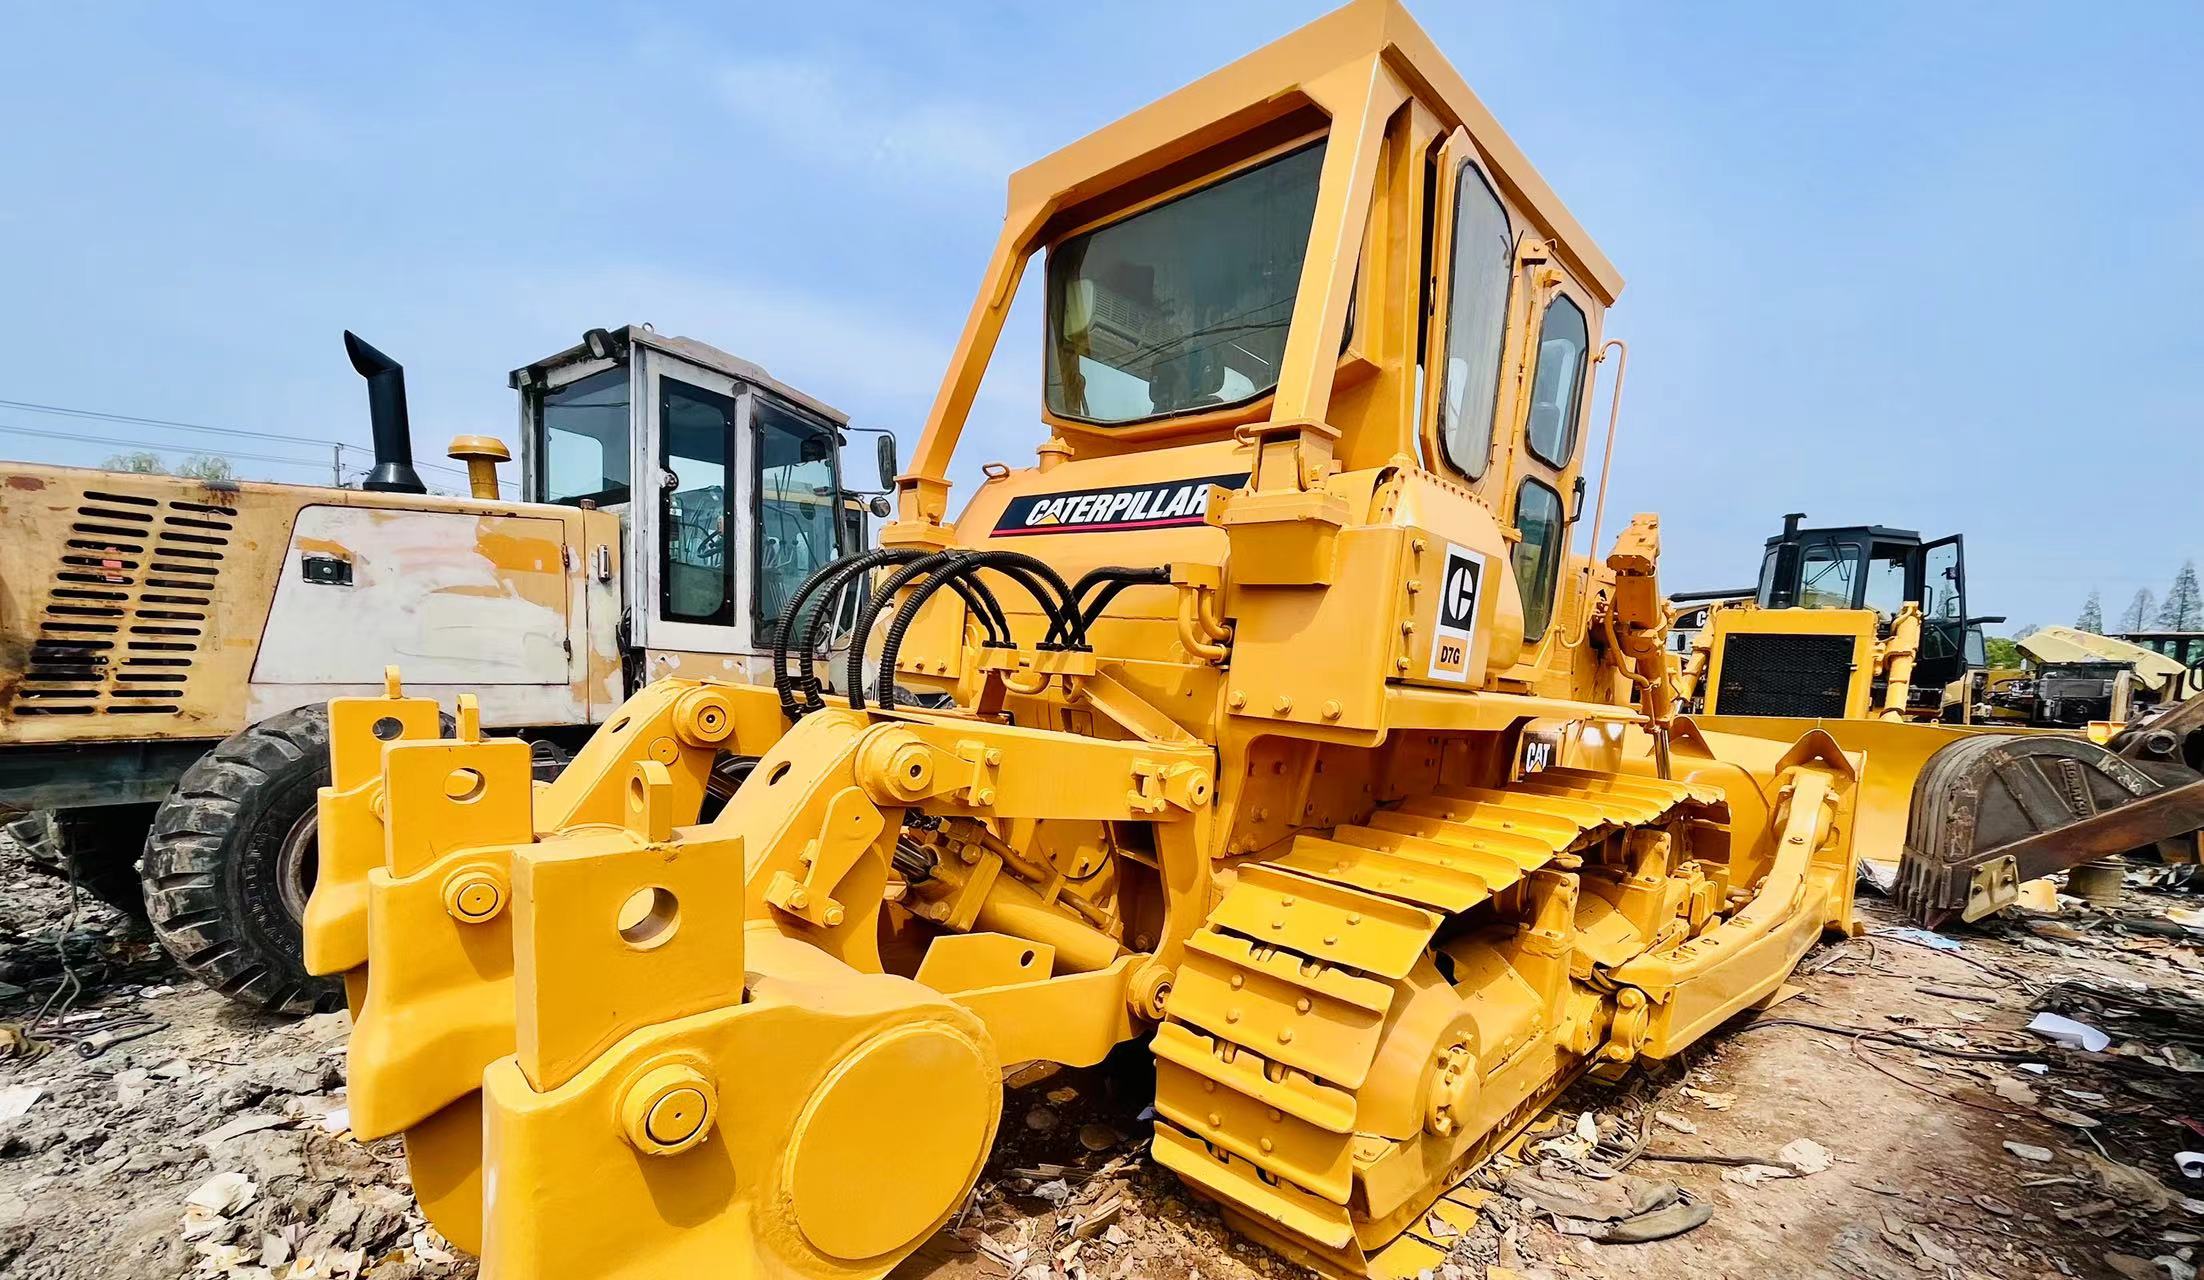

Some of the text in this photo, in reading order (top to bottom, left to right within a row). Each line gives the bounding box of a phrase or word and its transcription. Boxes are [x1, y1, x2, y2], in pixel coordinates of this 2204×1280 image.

[1025, 484, 1207, 526] CATERPILLAR
[1440, 645, 1461, 665] D7G
[1525, 742, 1551, 773] CAT
